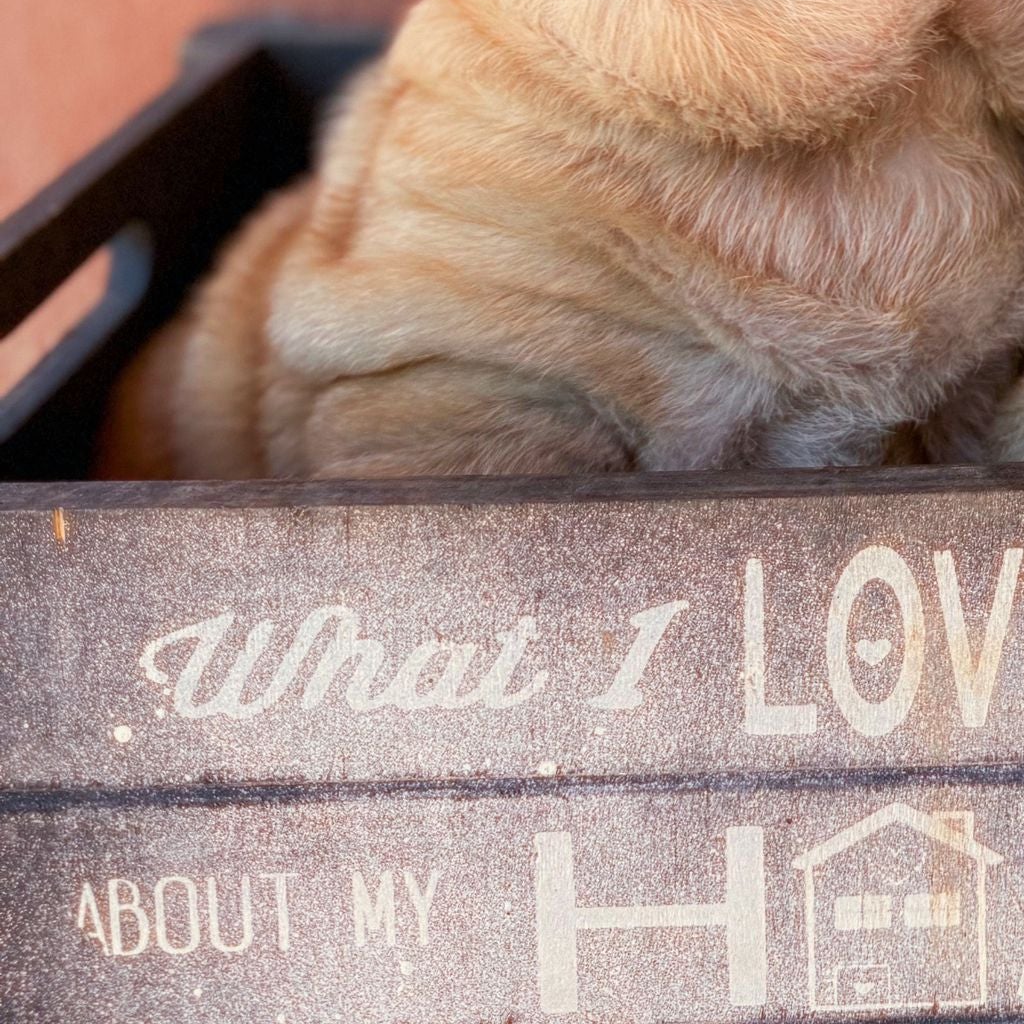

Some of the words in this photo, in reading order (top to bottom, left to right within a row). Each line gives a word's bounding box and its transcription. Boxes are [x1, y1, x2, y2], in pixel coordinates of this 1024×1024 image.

[140, 604, 548, 718] What
[76, 872, 298, 958] ABOUT
[353, 874, 438, 948] MY
